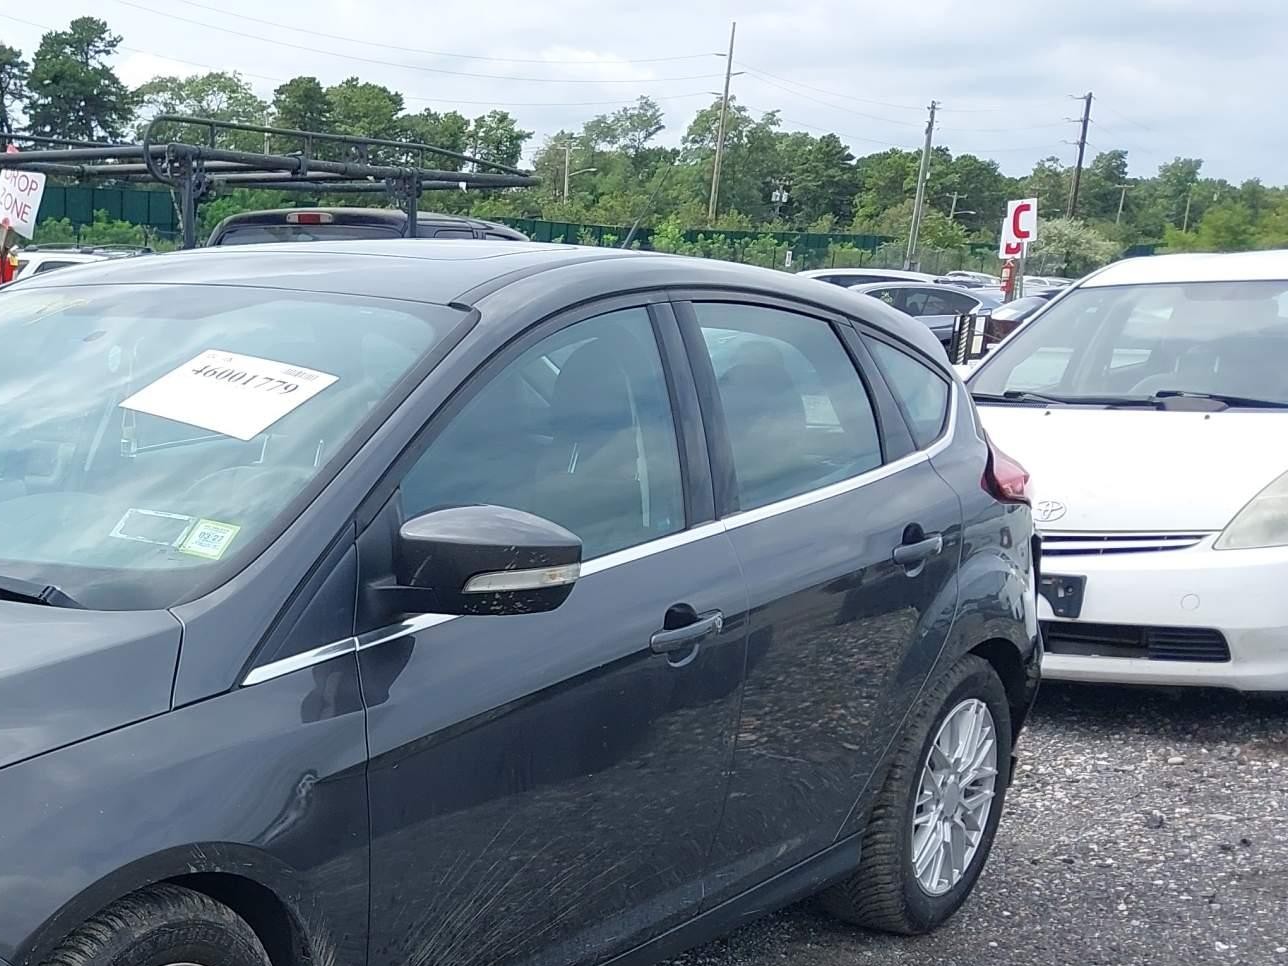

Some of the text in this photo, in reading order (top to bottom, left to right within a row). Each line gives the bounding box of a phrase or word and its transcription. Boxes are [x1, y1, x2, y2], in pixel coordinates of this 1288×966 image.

[4, 169, 38, 196] DROP
[1013, 204, 1030, 238] C
[191, 364, 300, 395] 46001779
